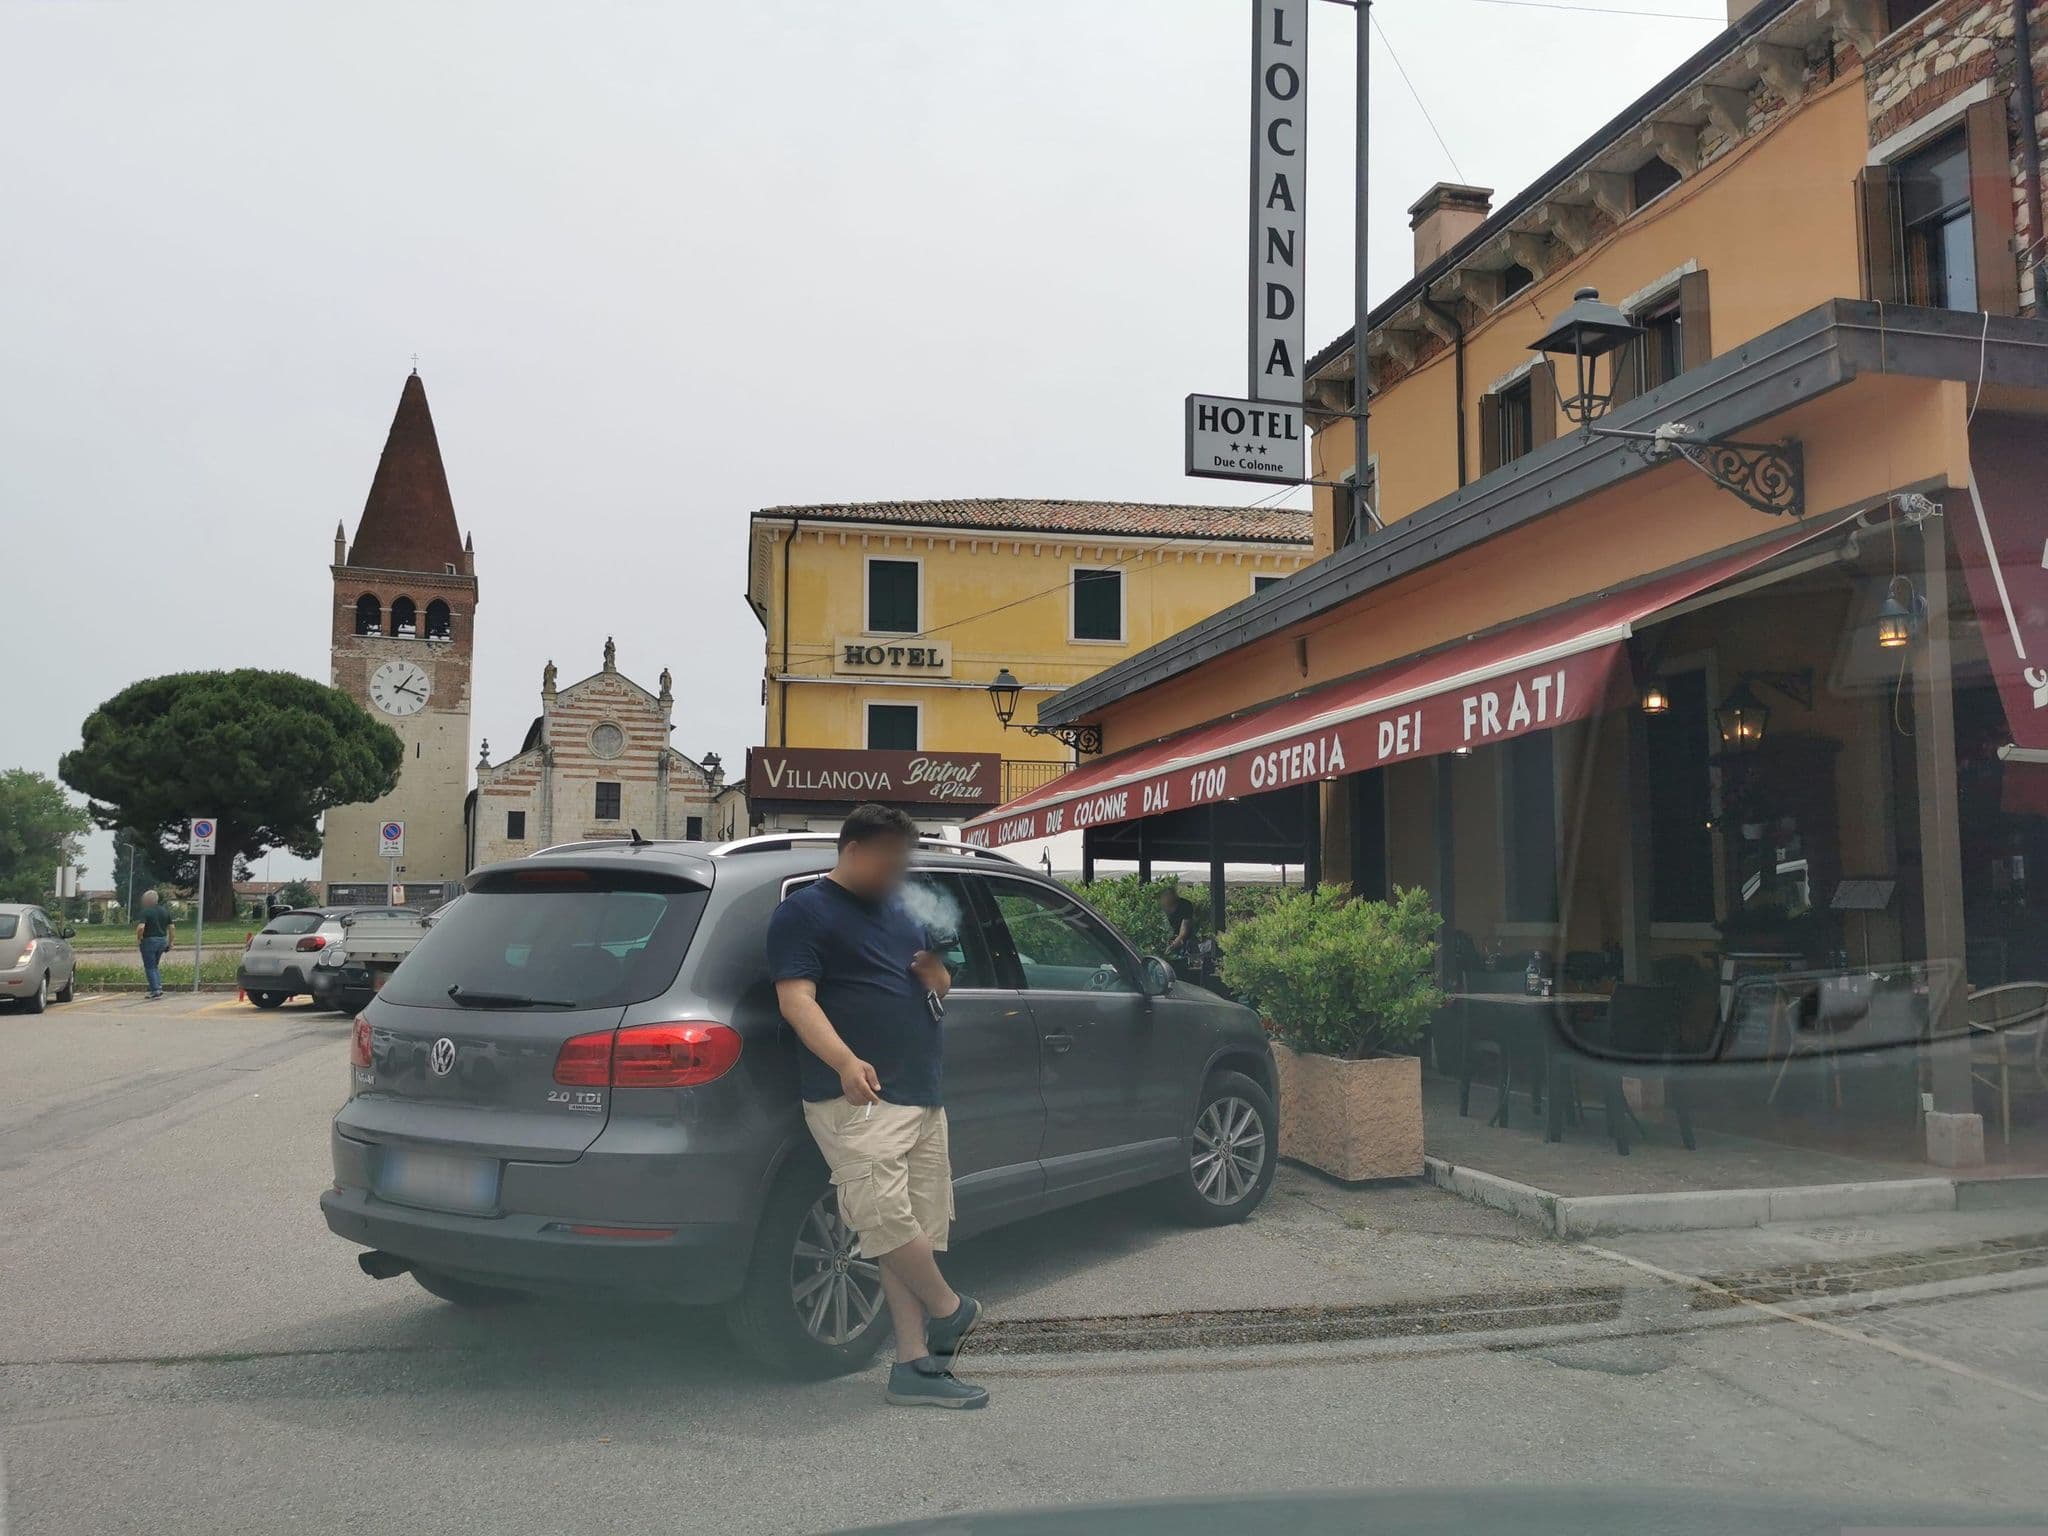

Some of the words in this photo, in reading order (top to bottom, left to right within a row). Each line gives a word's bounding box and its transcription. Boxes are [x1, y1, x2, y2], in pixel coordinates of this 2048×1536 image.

[1265, 8, 1300, 377] LOCANDA
[1198, 404, 1298, 440] HOTEL
[1214, 456, 1236, 468] Due
[1239, 459, 1284, 473] Colonne
[844, 645, 944, 667] HOTEL
[763, 758, 892, 791] VILLANOVA
[902, 757, 982, 785] Bistrot
[966, 827, 990, 849] ANTICA
[998, 815, 1035, 844] LOCANDA
[1046, 808, 1064, 834] DUE
[1074, 791, 1128, 827] COLONNE
[1143, 780, 1169, 813] DAL
[1190, 765, 1226, 802] 1700
[1251, 733, 1346, 788] OSTERIA
[1378, 710, 1422, 760] DEI
[1462, 669, 1566, 741] FRATI
